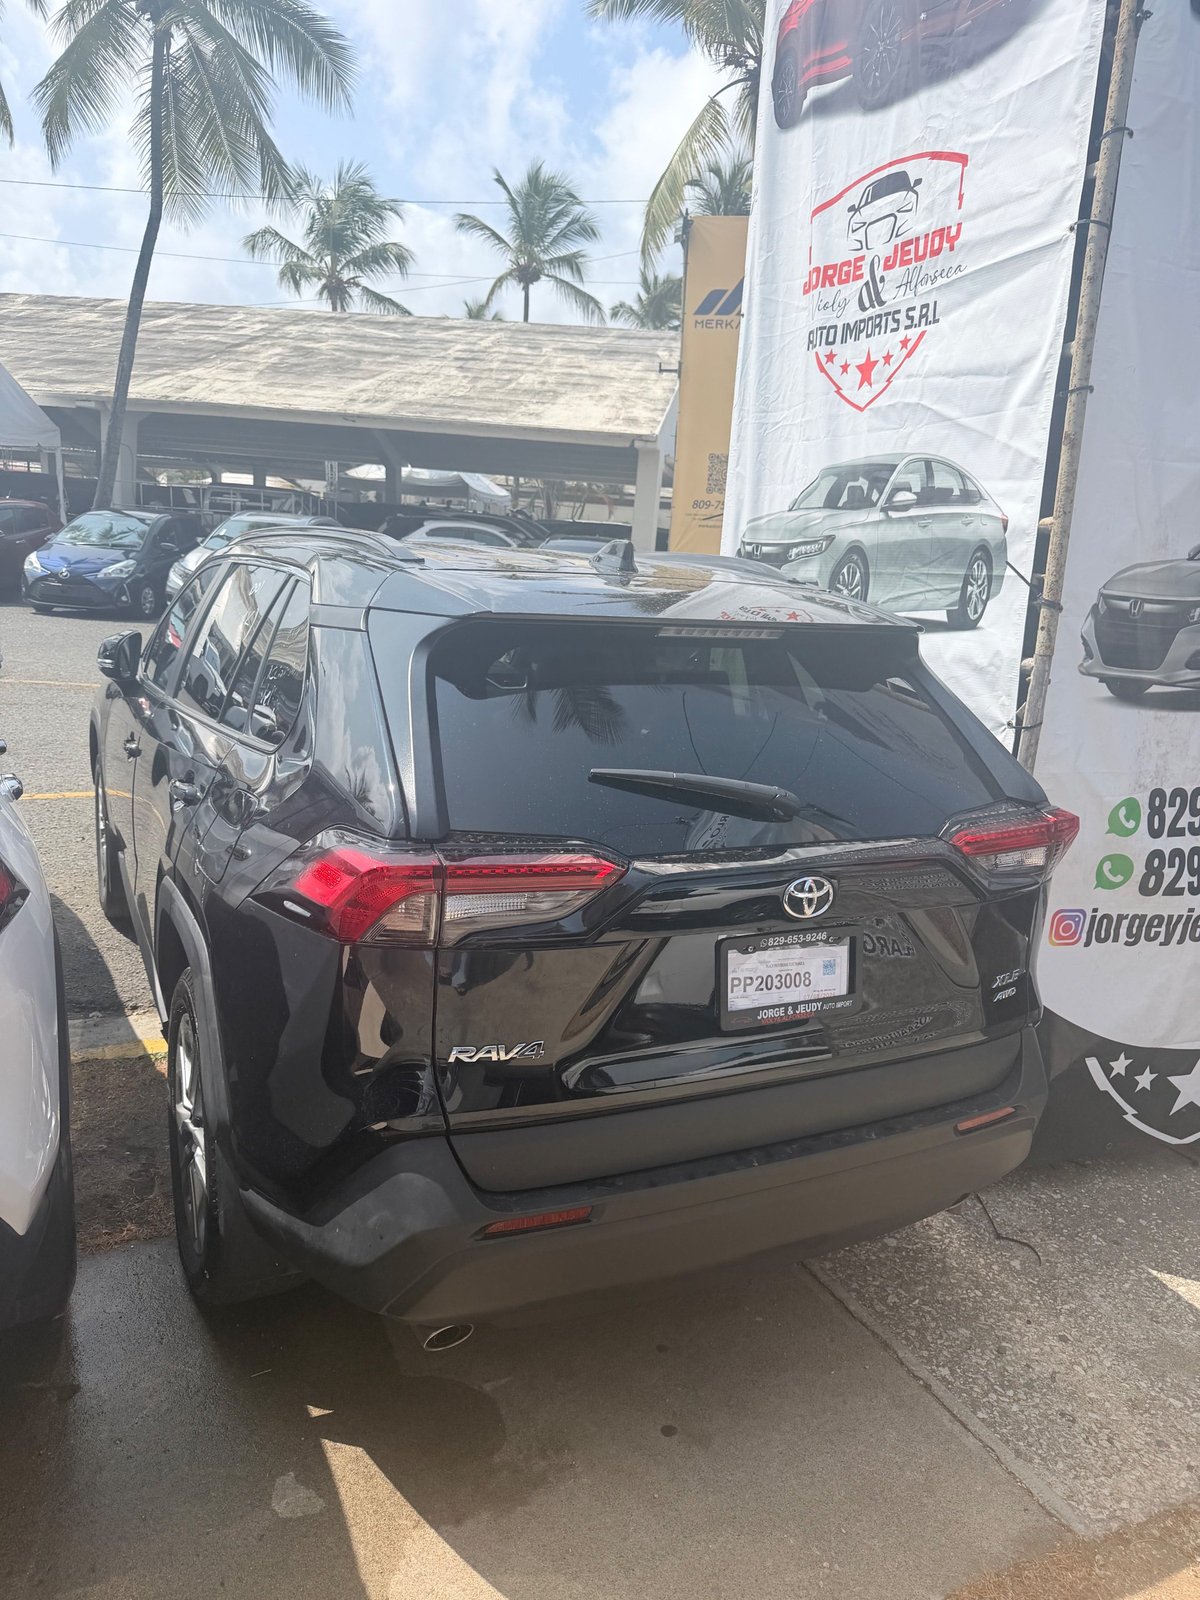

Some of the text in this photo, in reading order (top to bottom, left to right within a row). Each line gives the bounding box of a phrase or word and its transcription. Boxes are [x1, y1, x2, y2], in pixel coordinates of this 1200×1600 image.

[803, 222, 963, 313] JORGE & JEUDY
[892, 265, 968, 300] Alfonseca
[841, 309, 901, 345] IMPORTS
[1147, 786, 1200, 840] 829
[1138, 845, 1200, 897] 829
[768, 931, 827, 946] 829-653-9246
[1083, 907, 1200, 948] jorgeyje
[730, 971, 812, 994] PP203008
[757, 1006, 786, 1020] JORGE
[787, 1005, 794, 1015] &
[795, 1001, 823, 1014] JEUDY
[823, 1002, 835, 1010] AUTO
[447, 1040, 545, 1063] RAV4
